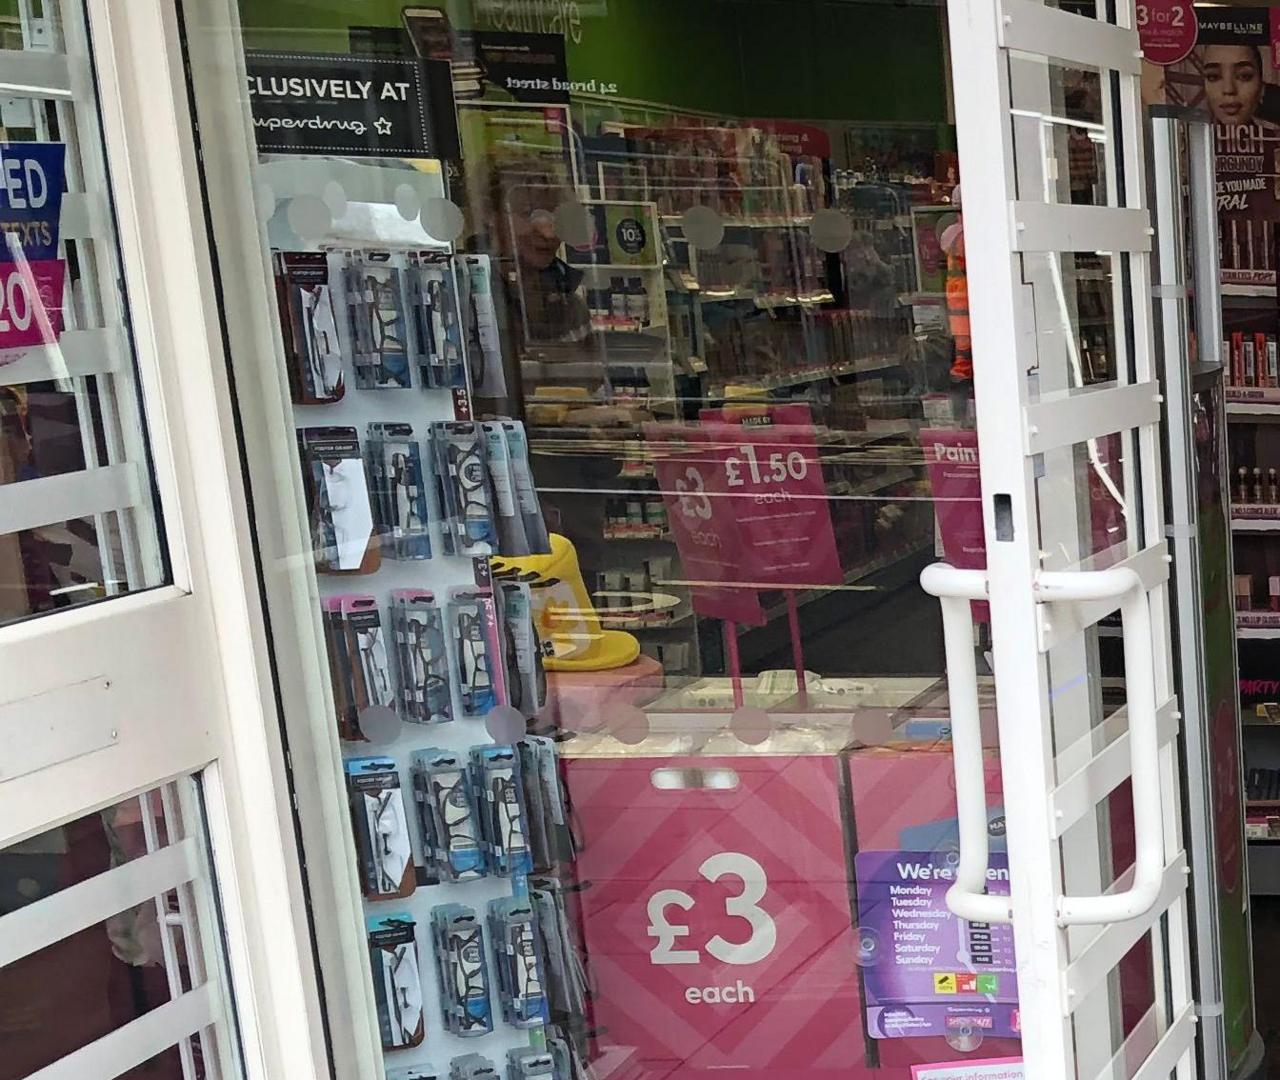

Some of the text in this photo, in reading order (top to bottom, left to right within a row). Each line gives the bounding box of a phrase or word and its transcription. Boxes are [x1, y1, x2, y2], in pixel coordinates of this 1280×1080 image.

[1151, 10, 1171, 23] for
[1171, 6, 1185, 27] 2
[1199, 22, 1263, 31] MAYBELLINE
[380, 82, 410, 100] AT
[1216, 124, 1264, 153] HIGH
[459, 388, 469, 414] +3.5
[934, 442, 977, 462] Pain
[725, 444, 807, 487] £1.50
[676, 467, 712, 520] £3
[754, 488, 791, 505] each
[897, 862, 952, 880] We're
[890, 886, 932, 896] Monday
[647, 852, 777, 965] £3
[891, 897, 932, 908] Tuesday
[892, 908, 952, 919] Wednesday
[893, 920, 940, 931] Thursday
[894, 932, 926, 942] Friday
[895, 943, 941, 954] Saturday
[896, 955, 935, 965] Sunday
[685, 980, 754, 1004] each
[965, 1070, 1024, 1080] information
